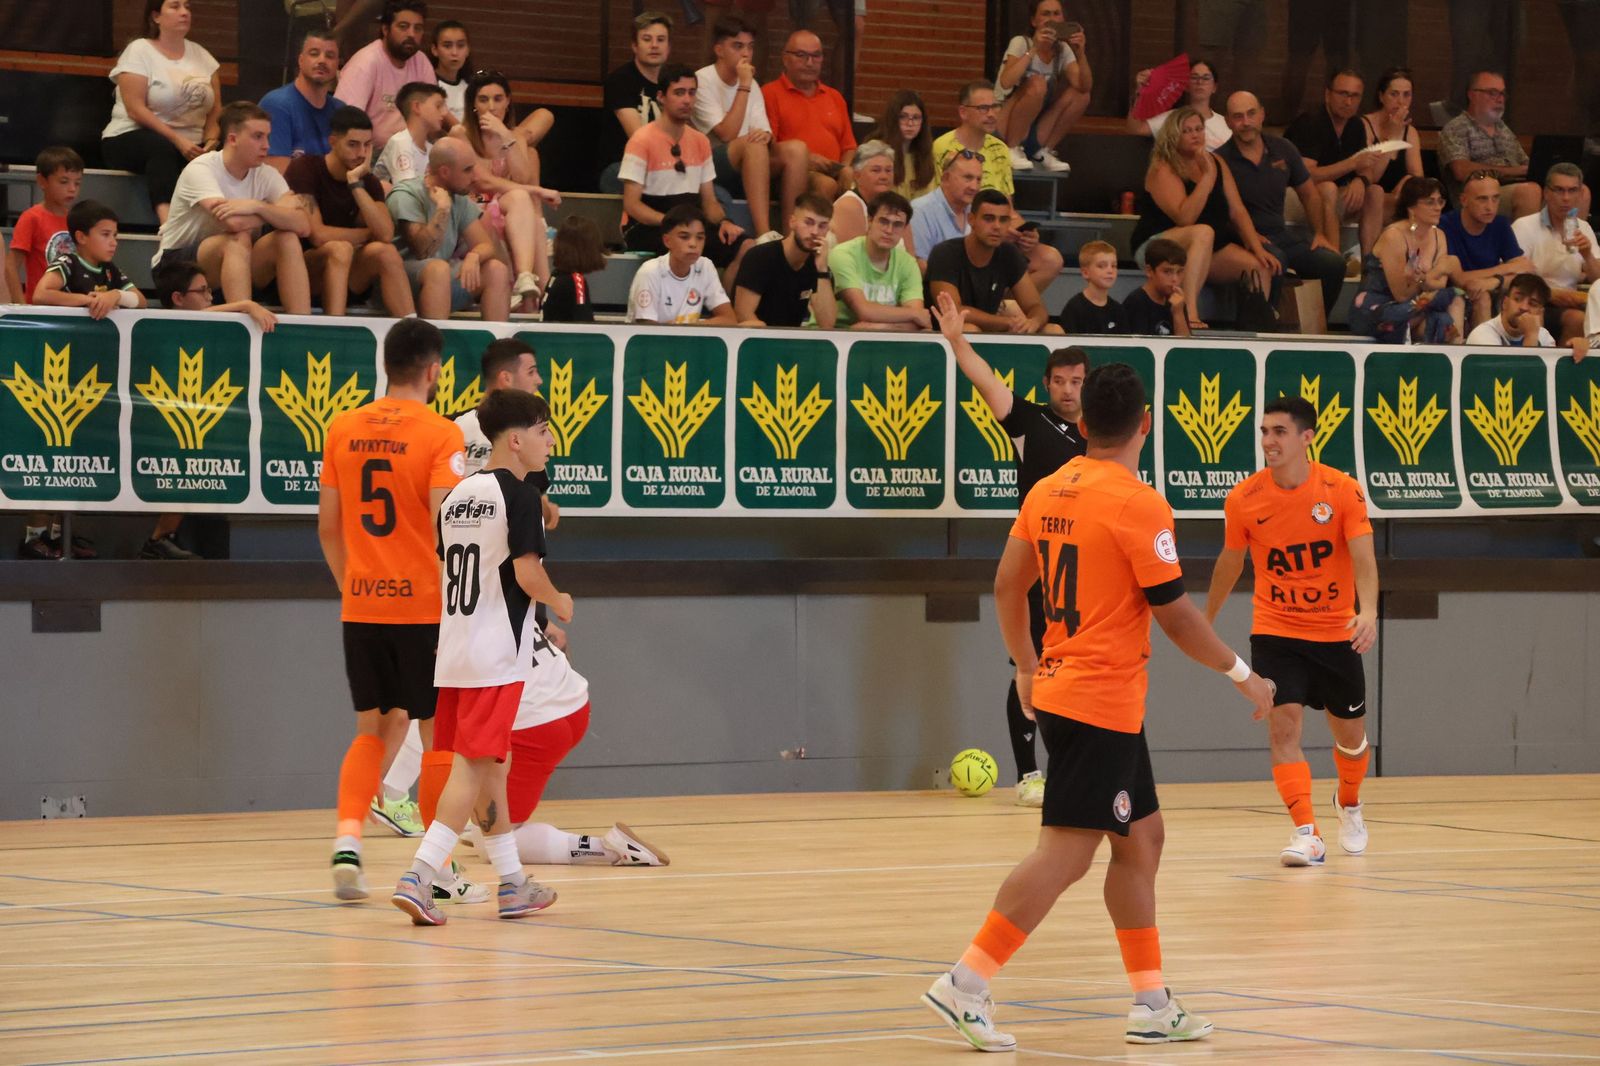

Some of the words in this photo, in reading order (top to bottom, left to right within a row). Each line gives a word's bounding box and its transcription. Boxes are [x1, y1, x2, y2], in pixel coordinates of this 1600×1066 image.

[1, 454, 48, 474] CAJA
[52, 455, 115, 474] RURAL
[136, 457, 181, 477] CAJA
[185, 457, 246, 477] RURAL
[265, 459, 309, 479] CAJA
[553, 464, 608, 482] RURAL
[23, 476, 41, 487] DE
[44, 476, 97, 488] ZAMORA
[626, 465, 665, 484] CAJA
[668, 465, 721, 483] RURAL
[739, 466, 778, 485] CAJA
[780, 467, 832, 483] RURAL
[850, 467, 887, 485] CAJA
[890, 468, 941, 484] RURAL
[958, 469, 996, 486] CAJA
[1168, 470, 1204, 487] CAJA
[1370, 471, 1405, 489] CAJA
[1407, 472, 1455, 487] RURAL
[1469, 471, 1505, 489] CAJA
[1506, 472, 1554, 487] RURAL
[1568, 472, 1600, 488] CAJA
[156, 478, 174, 490] DE
[177, 478, 227, 490] ZAMORA
[284, 480, 300, 491] DE
[643, 484, 658, 496] DE
[661, 484, 705, 496] ZAMORA
[756, 485, 771, 497] DE
[773, 485, 816, 497] ZAMORA
[866, 487, 881, 497] DE
[883, 487, 925, 498] ZAMORA
[974, 487, 988, 498] DE
[991, 487, 1020, 498] ZAMO
[1184, 488, 1198, 498] DE
[1200, 488, 1231, 498] ZAMO
[361, 458, 396, 537] 5
[1387, 489, 1401, 499] DE
[1403, 489, 1444, 499] ZAMORA
[1488, 489, 1503, 498] DE
[1504, 489, 1544, 498] ZAMORA
[1041, 516, 1075, 536] TERRY
[1267, 540, 1333, 574] ATP
[351, 578, 414, 597] uvesa
[446, 543, 481, 616] 80
[1038, 539, 1081, 638] 14
